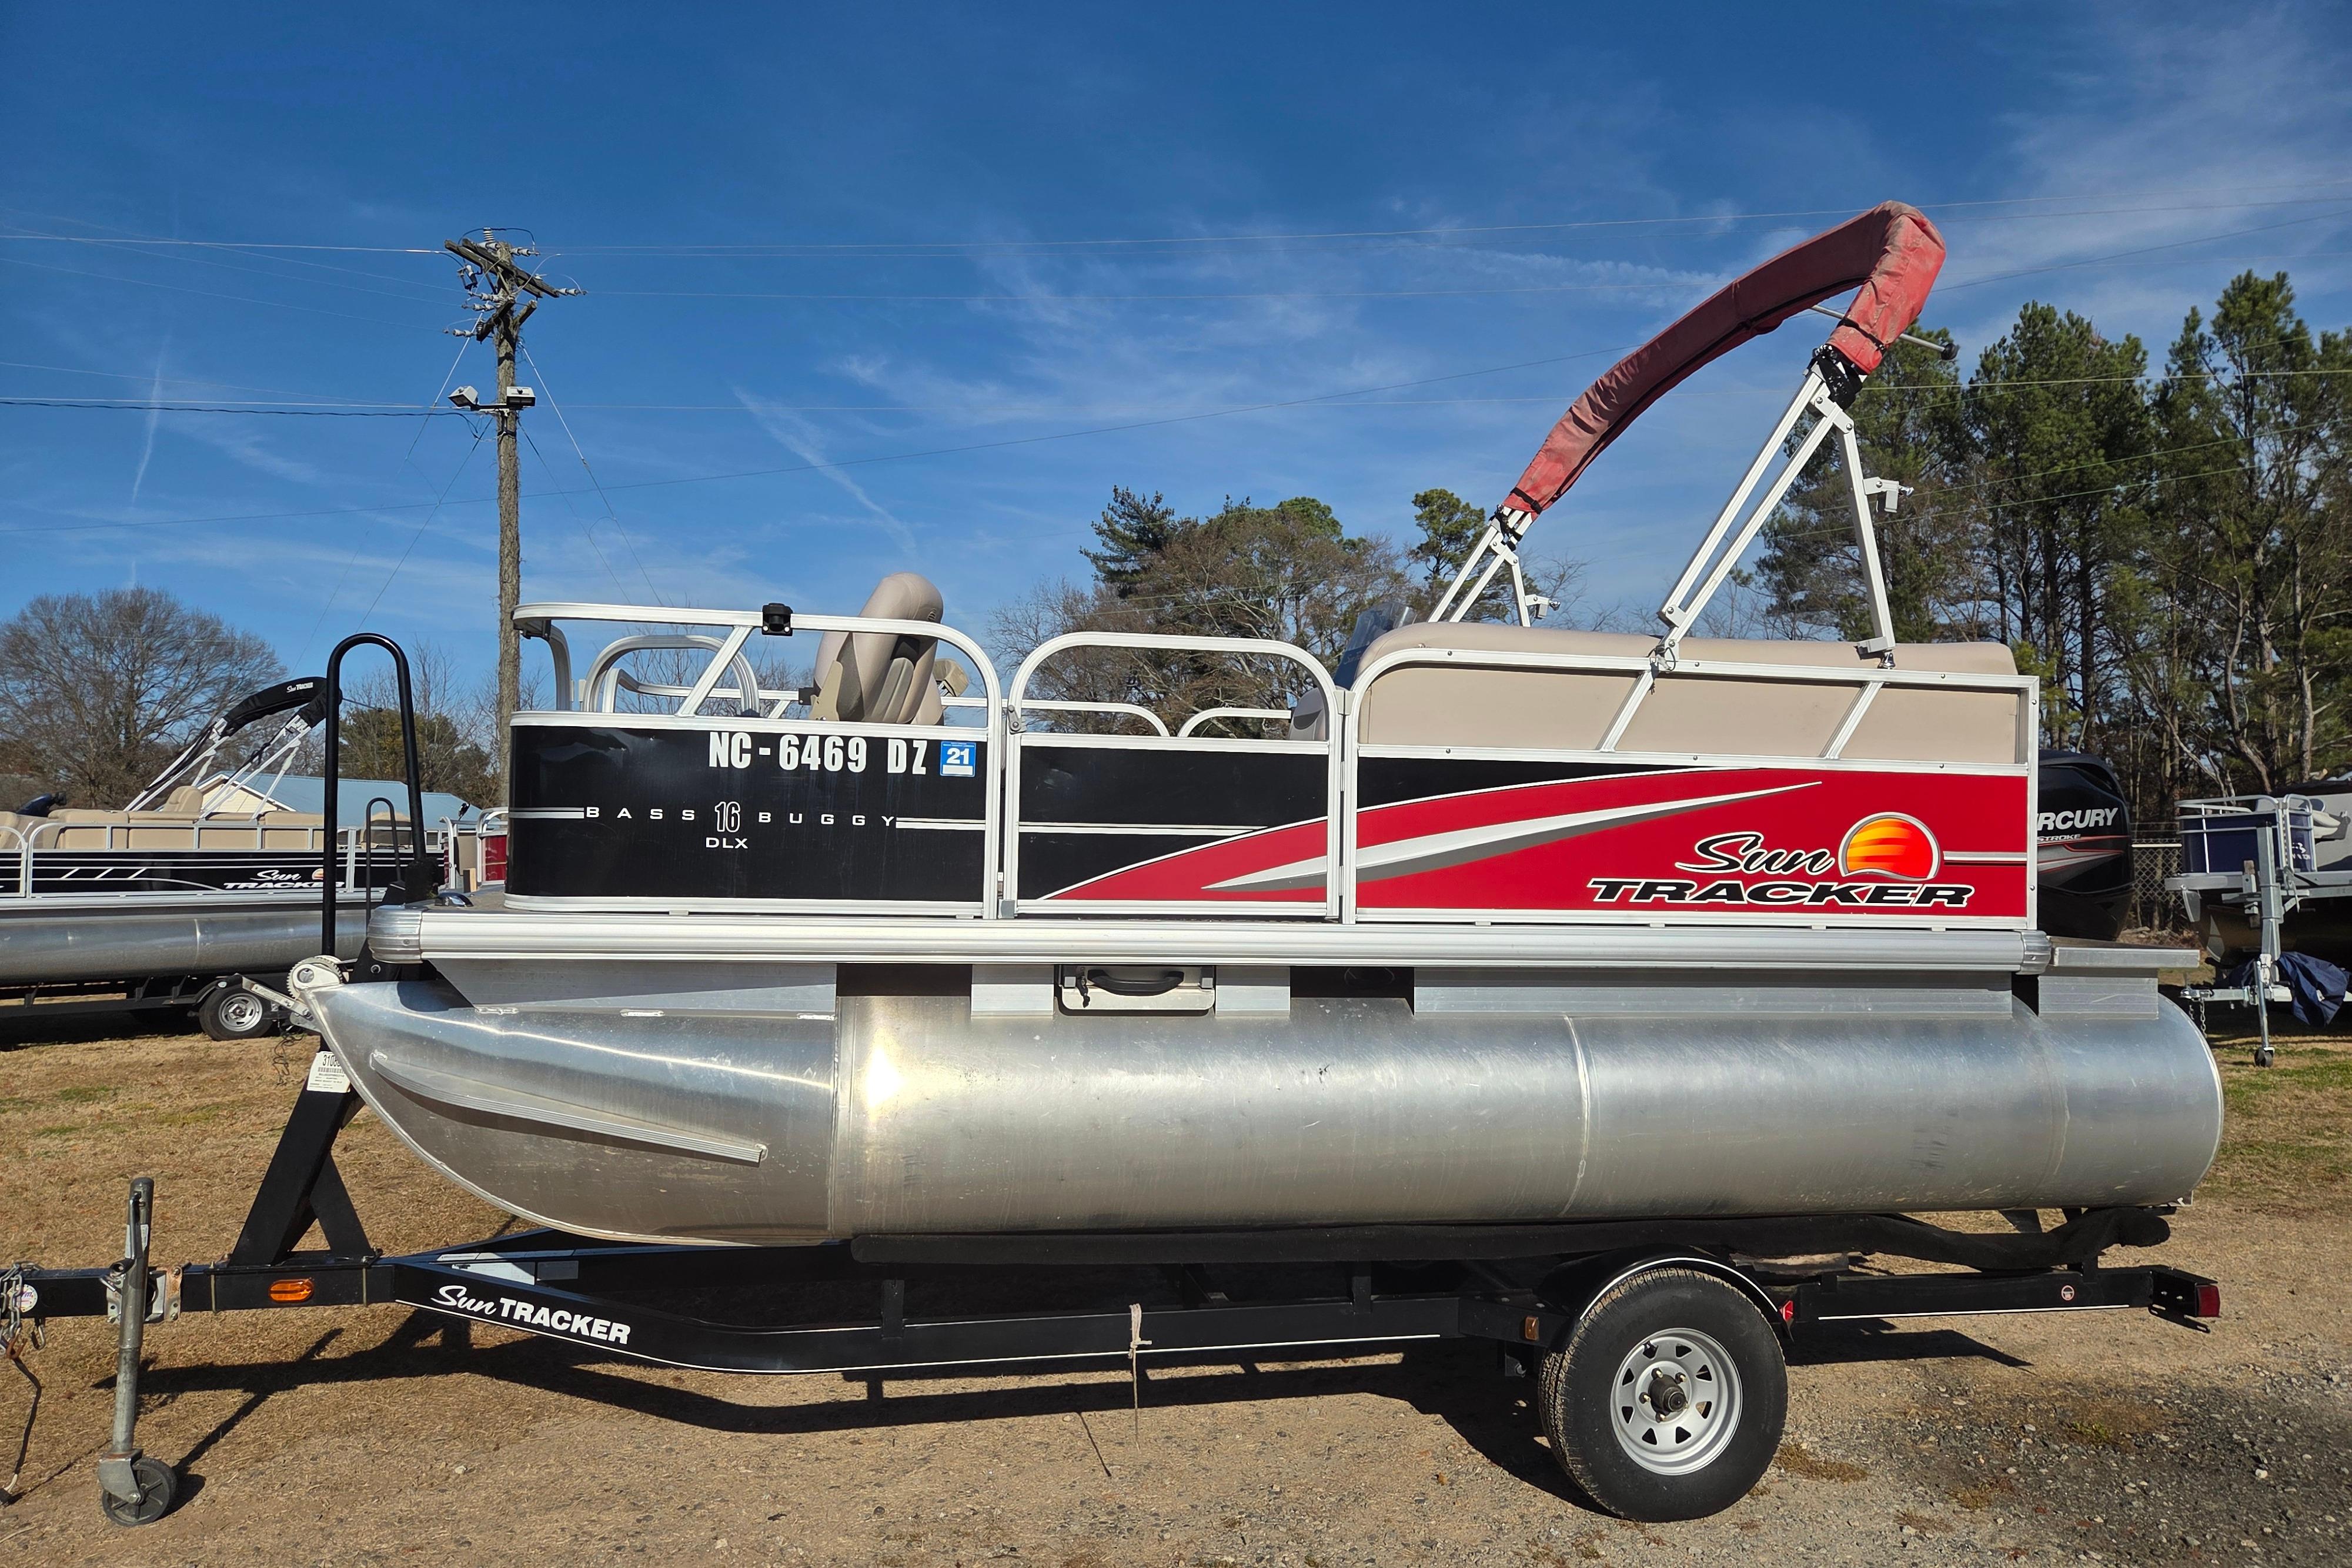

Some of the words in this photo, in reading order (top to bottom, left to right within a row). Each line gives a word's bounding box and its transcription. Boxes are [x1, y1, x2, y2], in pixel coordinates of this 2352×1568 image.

[887, 738, 928, 774] DZ
[947, 747, 969, 764] 21
[586, 806, 695, 821] BASS
[714, 801, 740, 833] 16
[758, 812, 894, 827] BUGGY
[2037, 807, 2118, 831] RCURY
[706, 837, 749, 848] DLX
[1675, 831, 1835, 875] Sun
[249, 870, 301, 881] Sun
[1587, 878, 1975, 907] TRACKER
[430, 1285, 497, 1315] Sun
[500, 1297, 631, 1345] TRACKER
